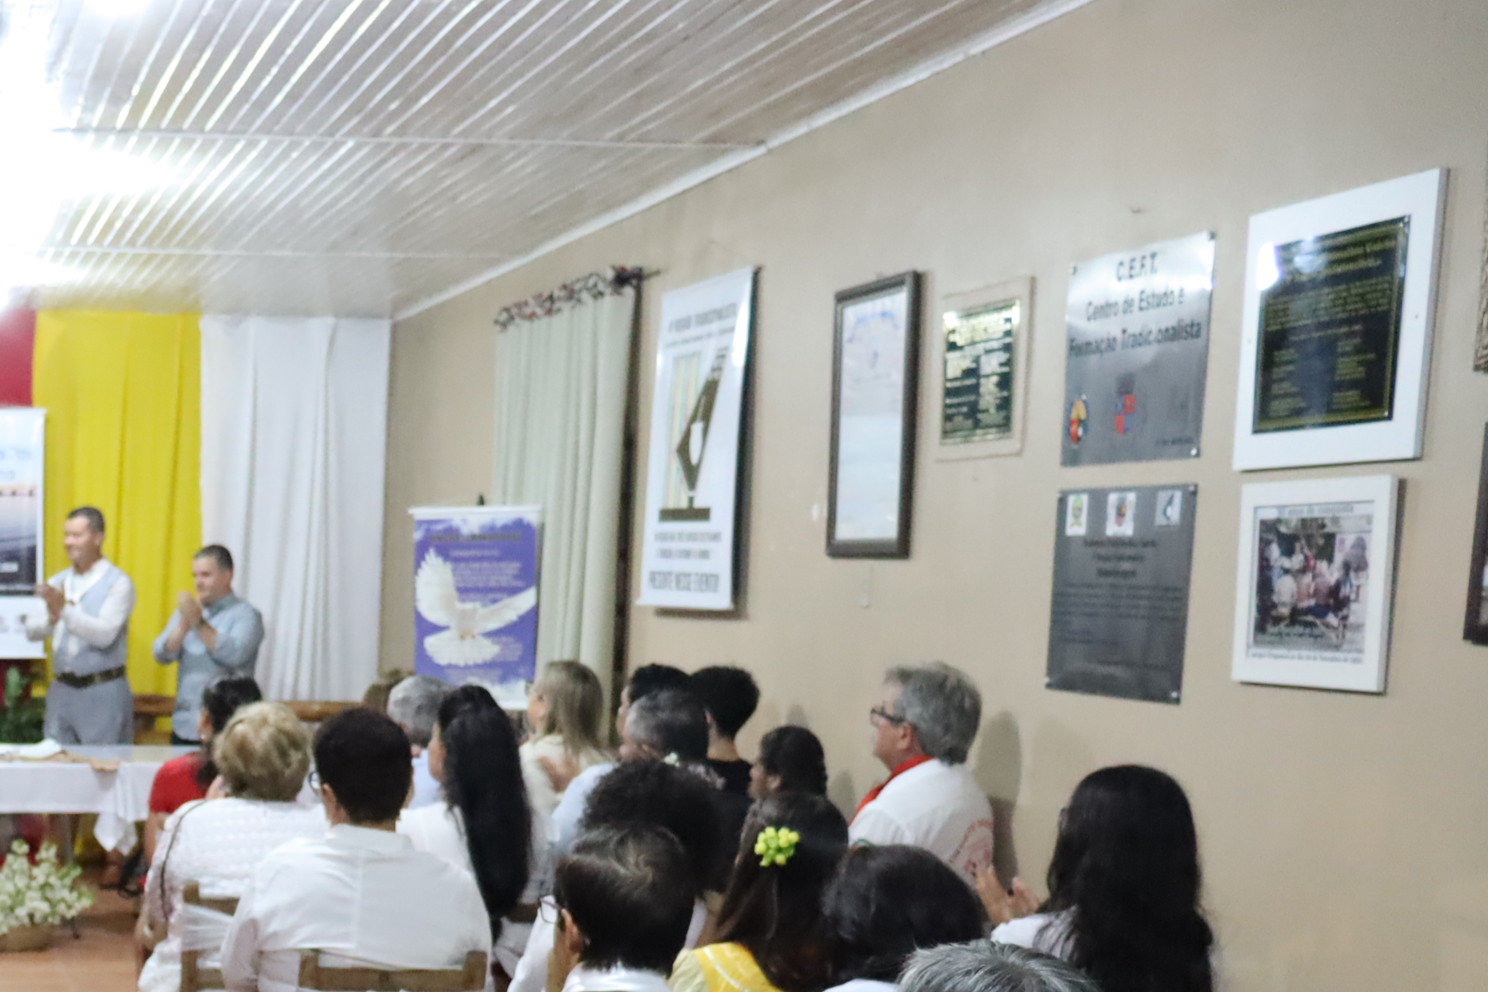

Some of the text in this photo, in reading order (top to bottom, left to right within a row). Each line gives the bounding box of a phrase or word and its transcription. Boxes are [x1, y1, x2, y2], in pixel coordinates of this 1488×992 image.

[1085, 300, 1119, 322] Centro
[1122, 296, 1135, 315] de
[1138, 287, 1175, 312] Estudo
[1068, 318, 1202, 358] Formação Tradicionalista
